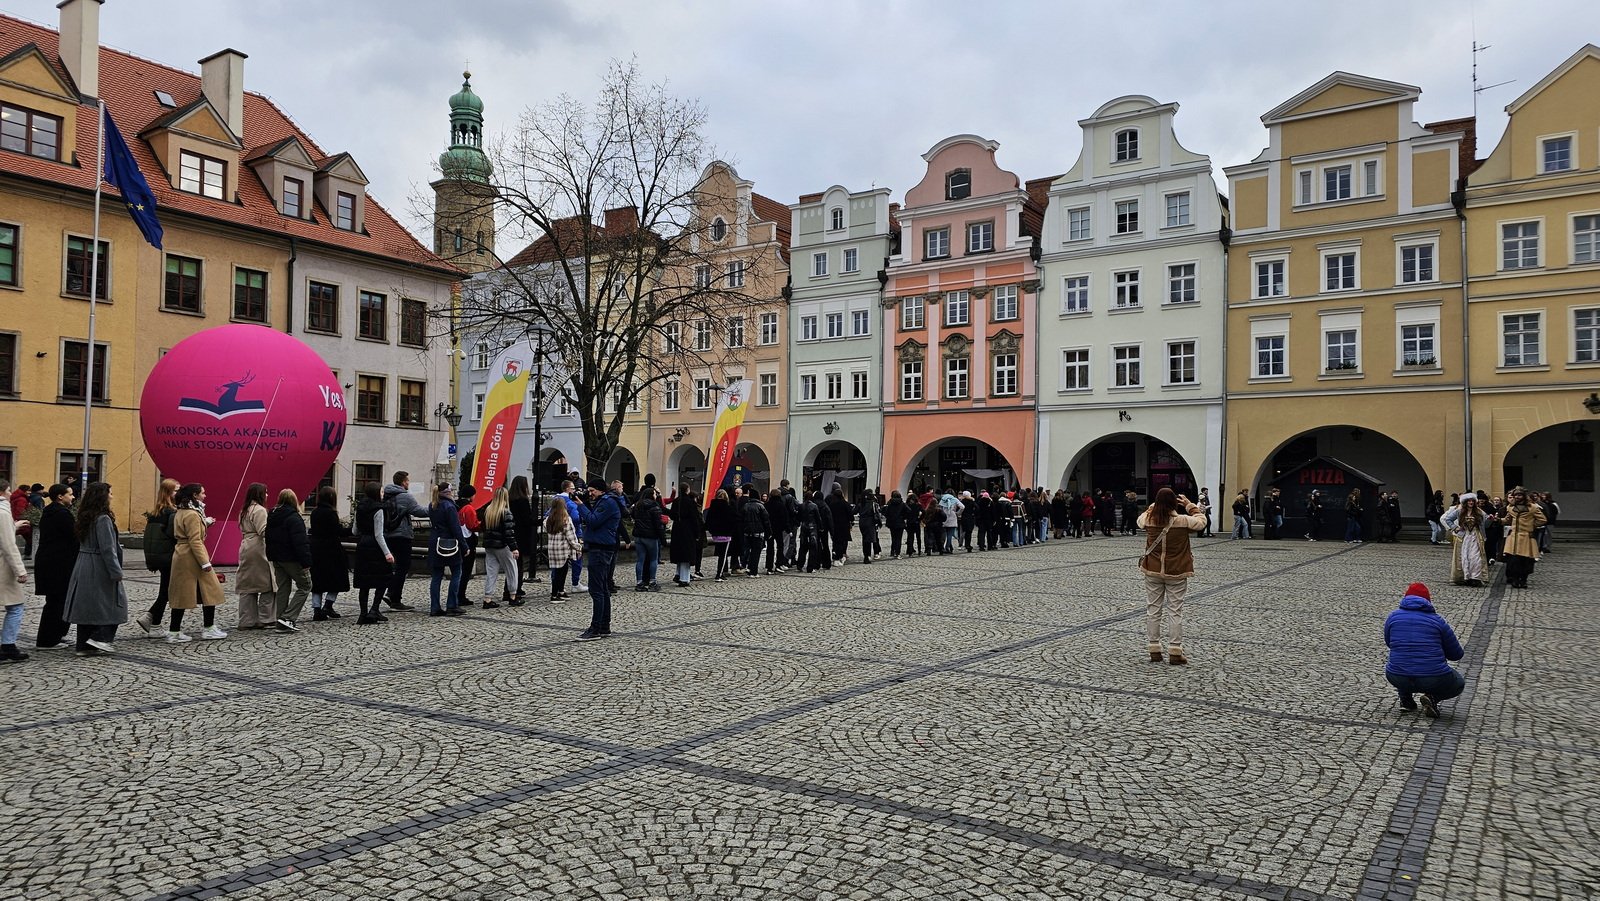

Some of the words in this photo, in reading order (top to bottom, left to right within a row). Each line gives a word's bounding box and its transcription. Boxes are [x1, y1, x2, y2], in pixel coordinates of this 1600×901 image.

[156, 425, 229, 437] KARKONOSKA
[234, 426, 298, 439] AKADEMIA
[490, 424, 504, 451] Góra
[164, 440, 191, 450] NAUK
[194, 440, 288, 452] STOSOWANYCH
[483, 454, 499, 492] Jelenia
[1300, 469, 1345, 484] PIZZA
